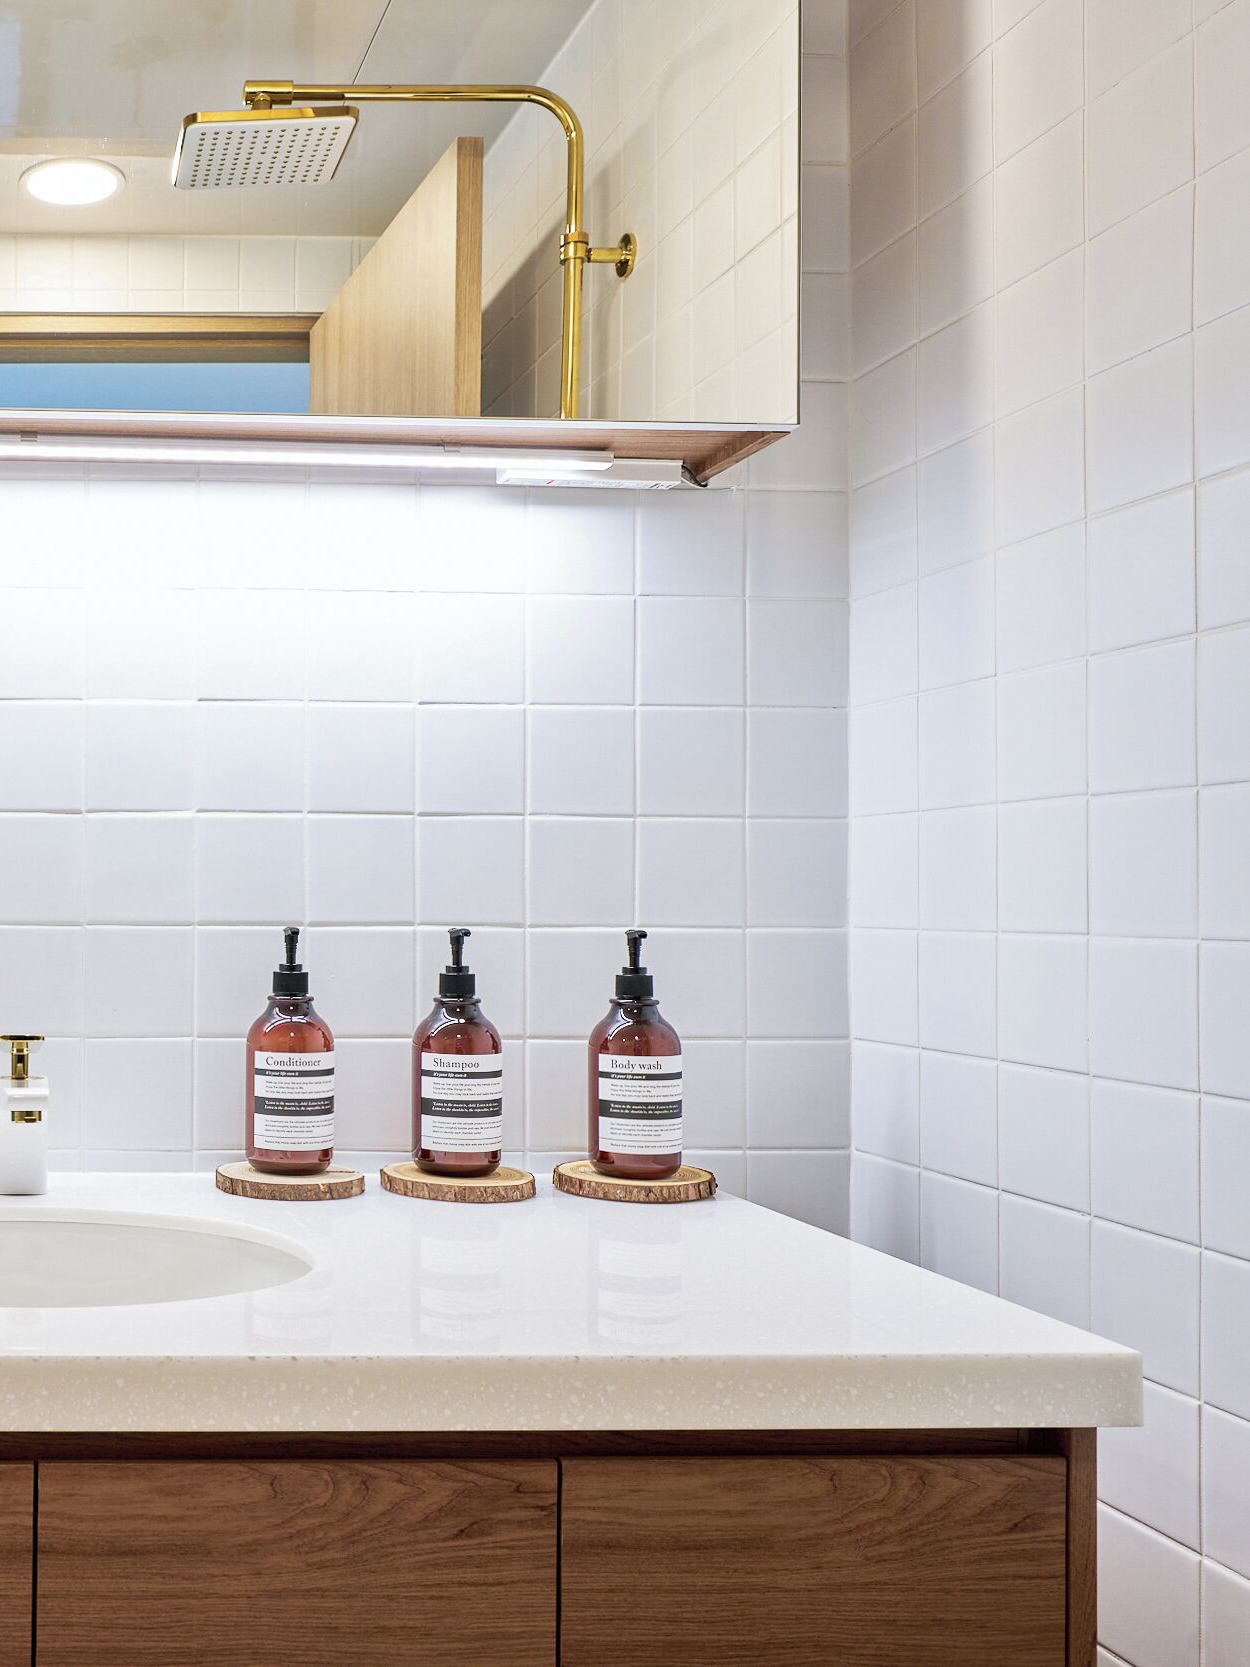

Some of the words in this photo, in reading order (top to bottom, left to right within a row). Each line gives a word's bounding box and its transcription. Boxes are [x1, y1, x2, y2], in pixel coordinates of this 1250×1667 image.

[265, 1056, 321, 1067] Conditioner
[433, 1058, 480, 1071] Shampoo
[611, 1059, 636, 1072] Body
[638, 1060, 662, 1070] wash
